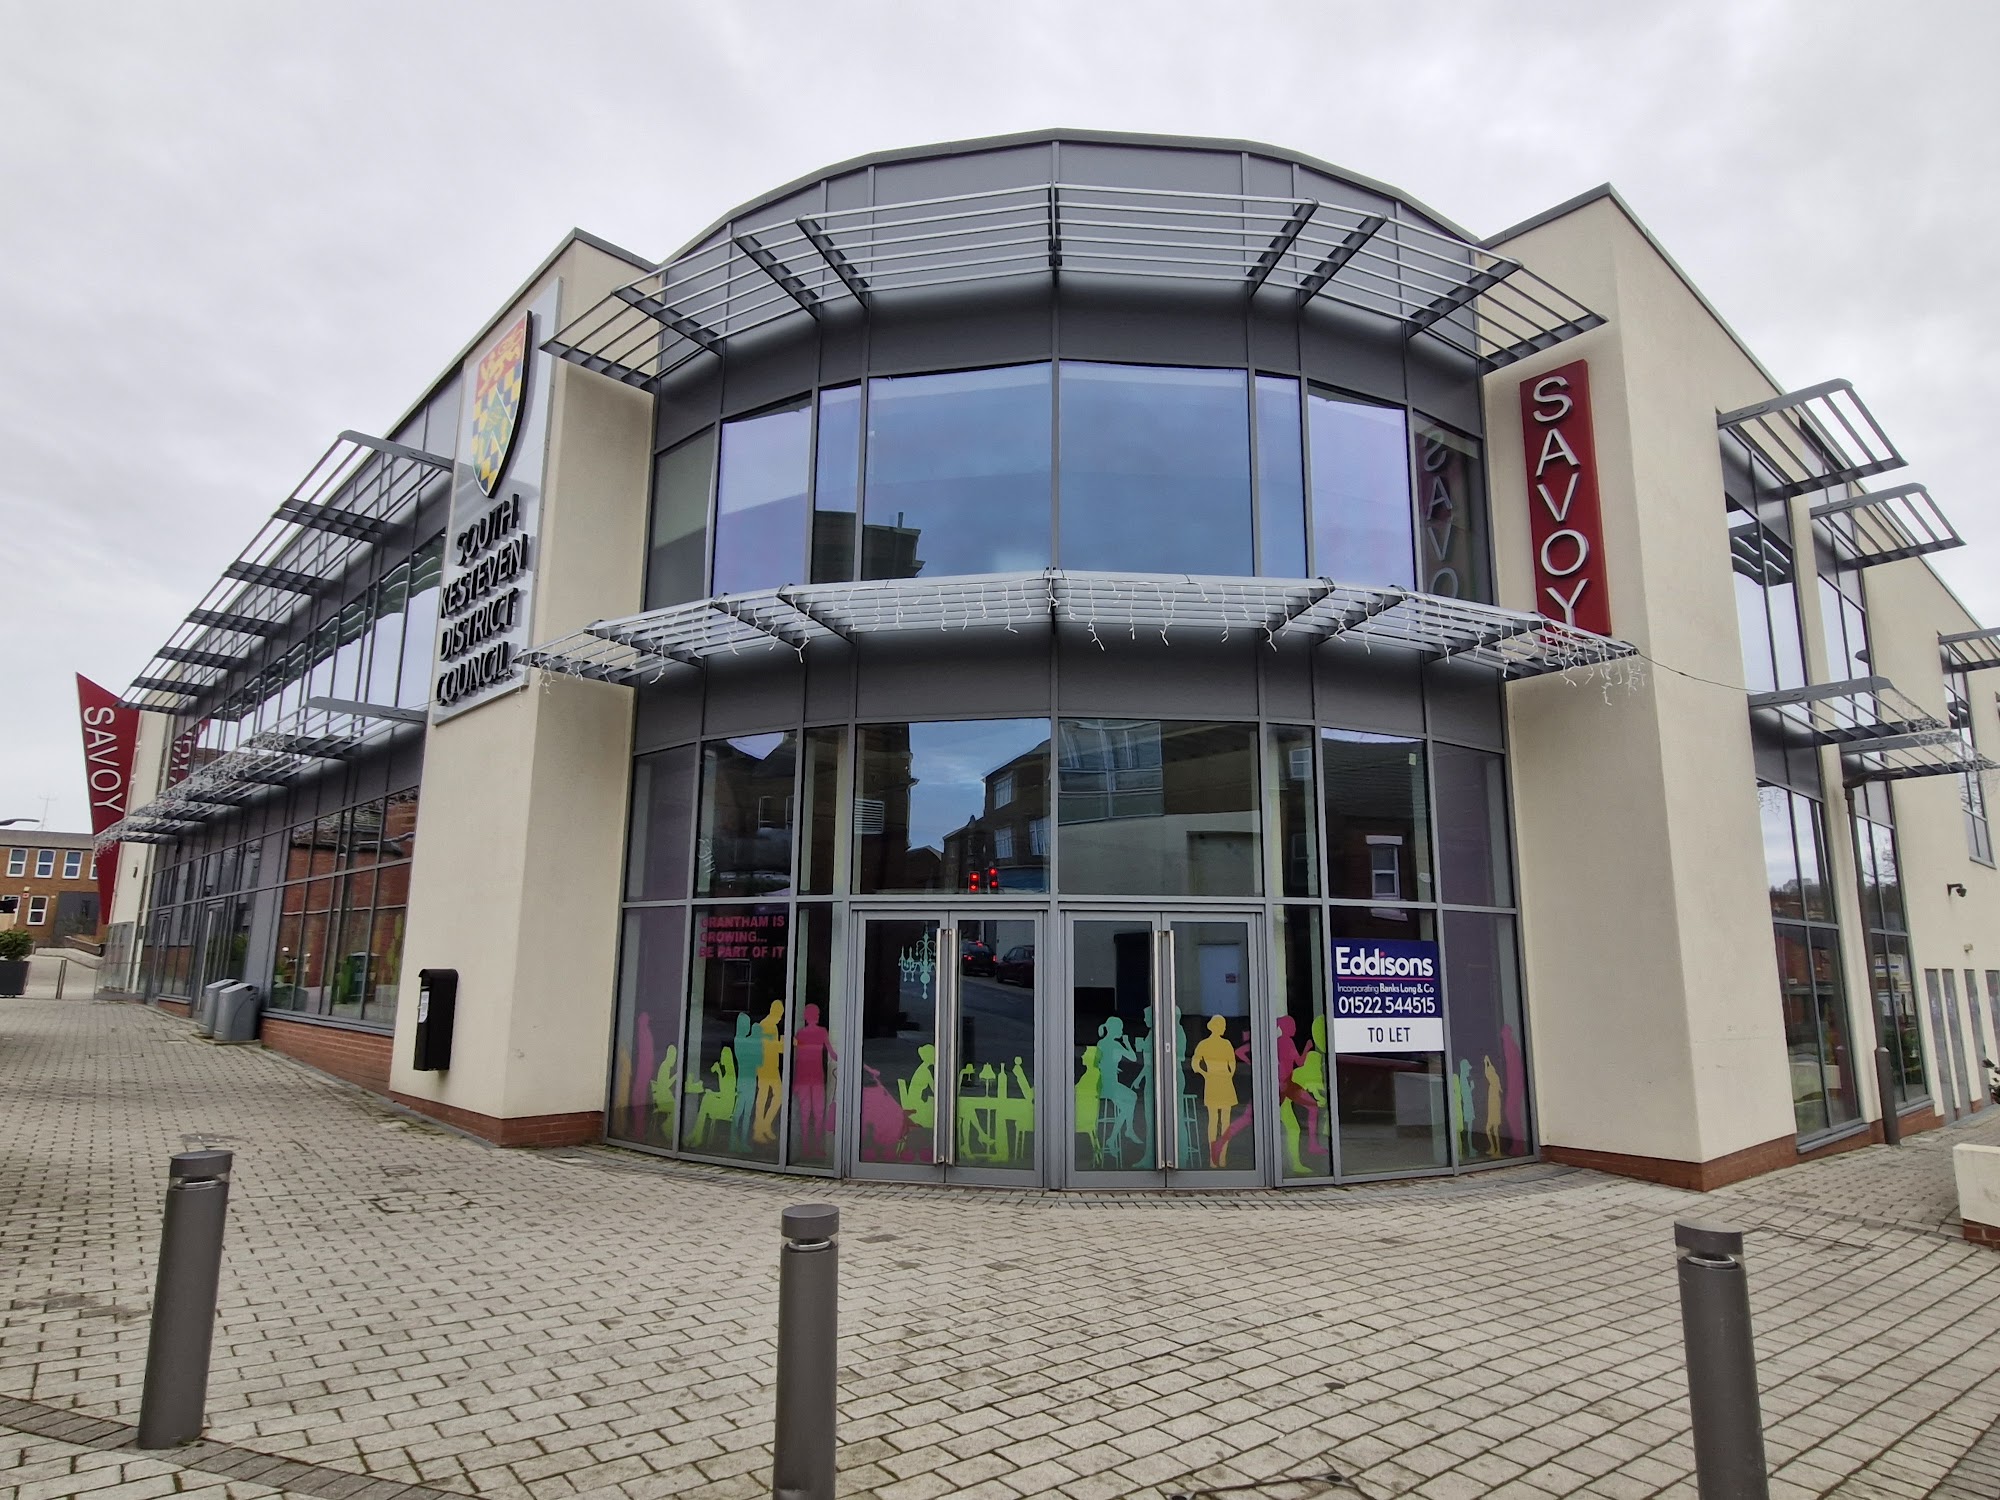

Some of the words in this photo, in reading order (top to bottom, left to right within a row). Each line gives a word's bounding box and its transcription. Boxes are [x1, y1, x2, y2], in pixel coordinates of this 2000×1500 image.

[1532, 375, 1590, 628] SAVOY
[457, 493, 520, 566] SOUTH
[440, 533, 529, 619] KESTEVEN
[440, 587, 519, 662] DISTRICT
[436, 641, 511, 706] COUNCIL
[83, 706, 125, 813] SAVOY
[702, 915, 769, 928] GRANTHAM
[772, 915, 785, 927] IS
[699, 946, 715, 958] BE
[717, 946, 748, 958] PART
[752, 946, 768, 957] OF
[772, 946, 786, 957] IT
[1335, 946, 1434, 977] Eddisons
[1337, 983, 1379, 994] Incorporating
[1380, 983, 1399, 993] Banks
[1400, 983, 1417, 995] Long
[1417, 984, 1423, 993] &
[1424, 984, 1435, 993] Co
[1338, 996, 1383, 1014] 01522
[1385, 996, 1436, 1014] 544515
[1367, 1027, 1384, 1043] TO
[1389, 1027, 1411, 1043] LET
